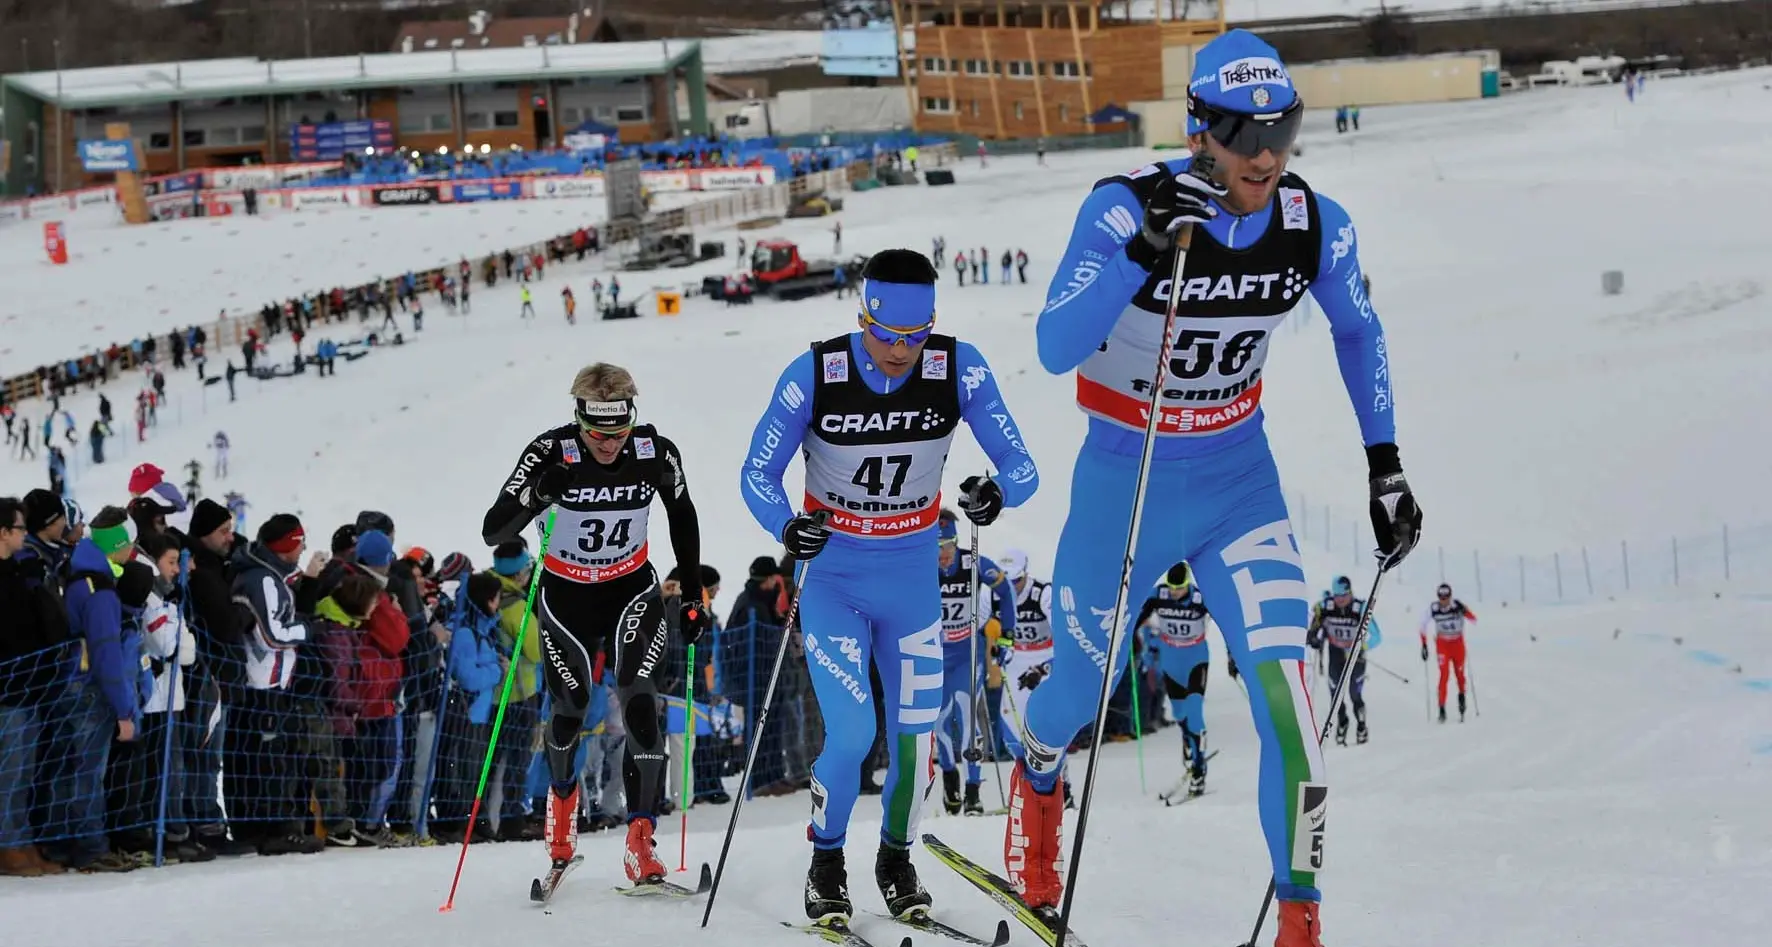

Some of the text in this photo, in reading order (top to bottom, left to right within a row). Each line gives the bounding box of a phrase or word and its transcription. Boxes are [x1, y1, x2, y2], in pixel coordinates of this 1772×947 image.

[1153, 273, 1280, 301] CRAFT
[821, 411, 920, 433] CRAFT
[752, 424, 783, 469] Audi
[505, 452, 542, 496] ALPIQ
[852, 454, 913, 498] 47
[577, 518, 633, 553] 34
[1219, 519, 1309, 652] ITA
[623, 601, 648, 643] odlo
[541, 629, 580, 690] swisscom
[637, 617, 668, 678] RAIFFEISEN
[814, 648, 868, 704] sportful
[898, 618, 944, 724] ITA
